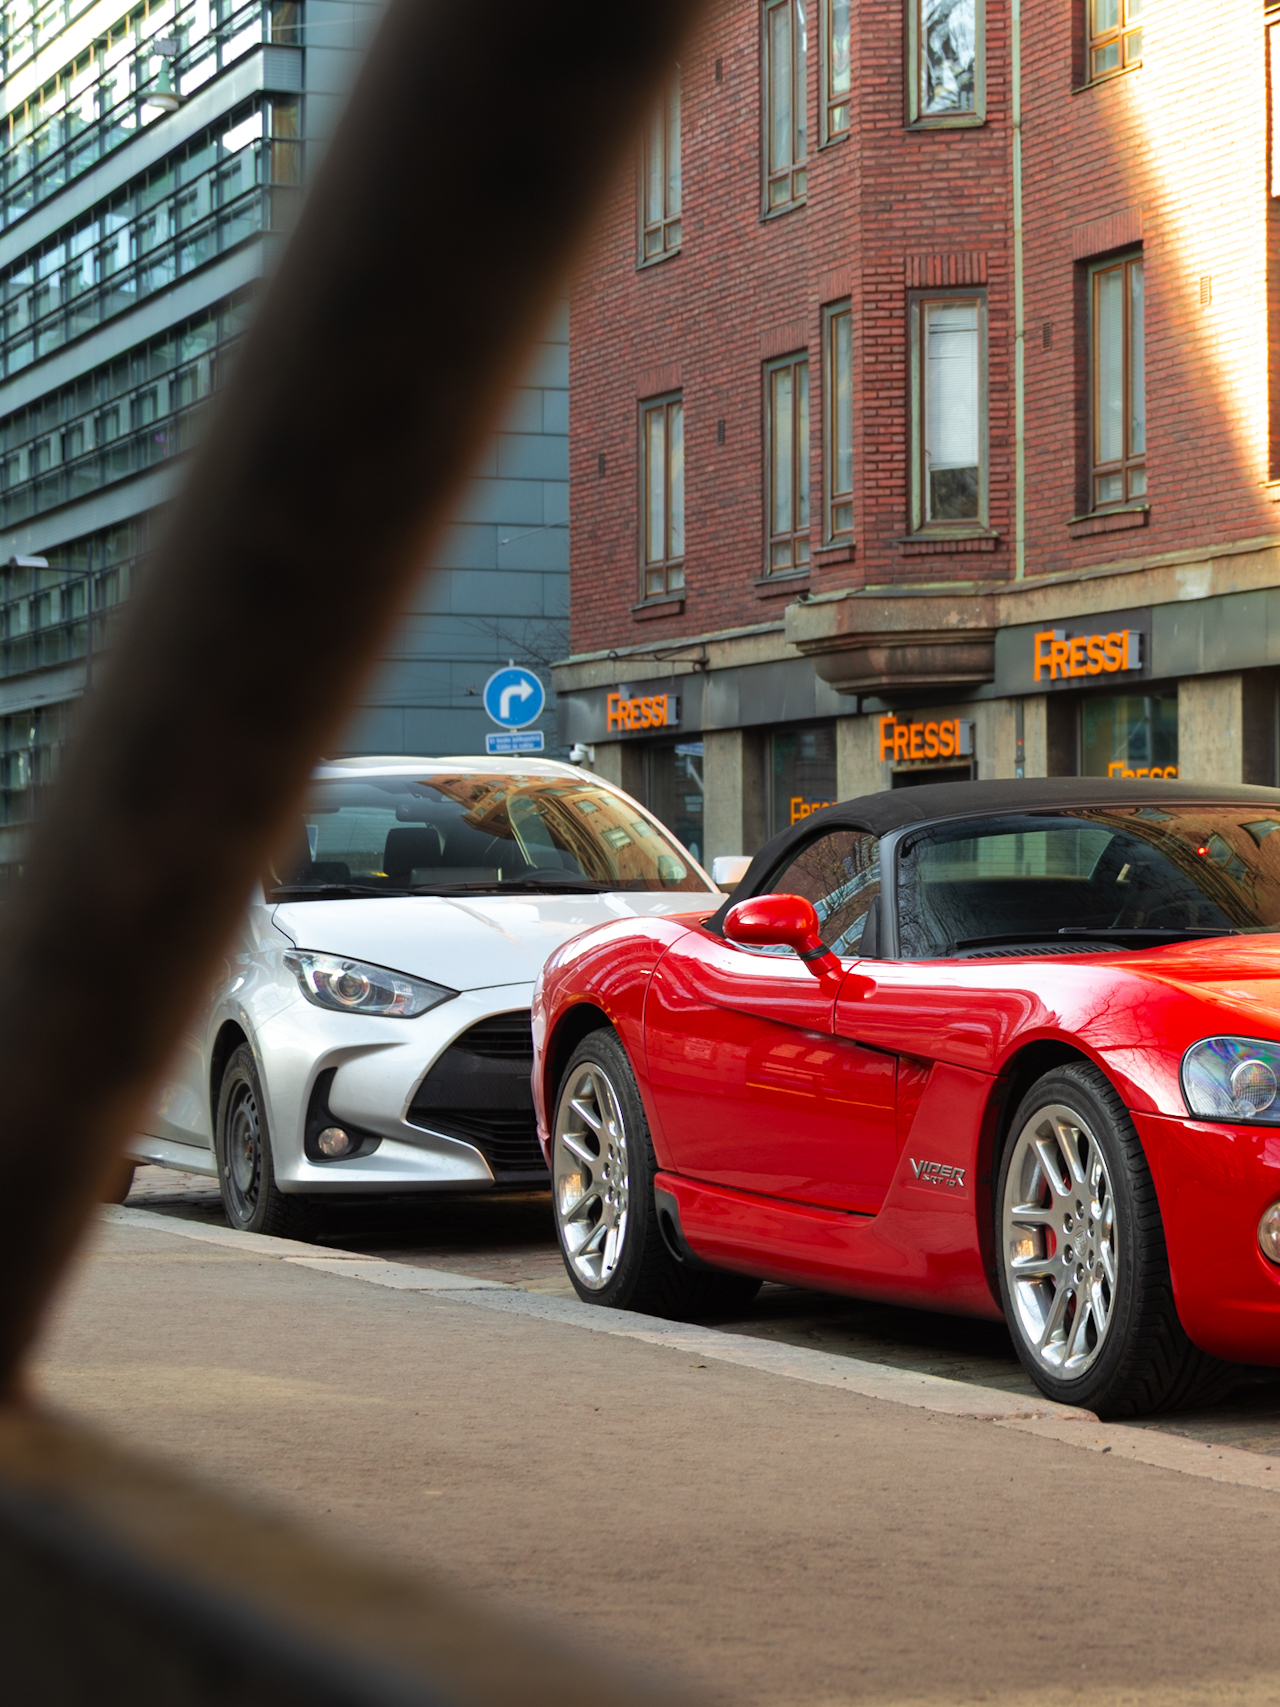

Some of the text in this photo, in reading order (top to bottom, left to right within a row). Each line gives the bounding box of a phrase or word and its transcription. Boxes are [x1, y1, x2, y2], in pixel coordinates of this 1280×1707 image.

[1034, 629, 1129, 682] FRESSI
[607, 692, 668, 732] FRESSI
[879, 716, 961, 762] FRESSI
[909, 1158, 965, 1186] VIPER
[922, 1174, 943, 1184] SRT
